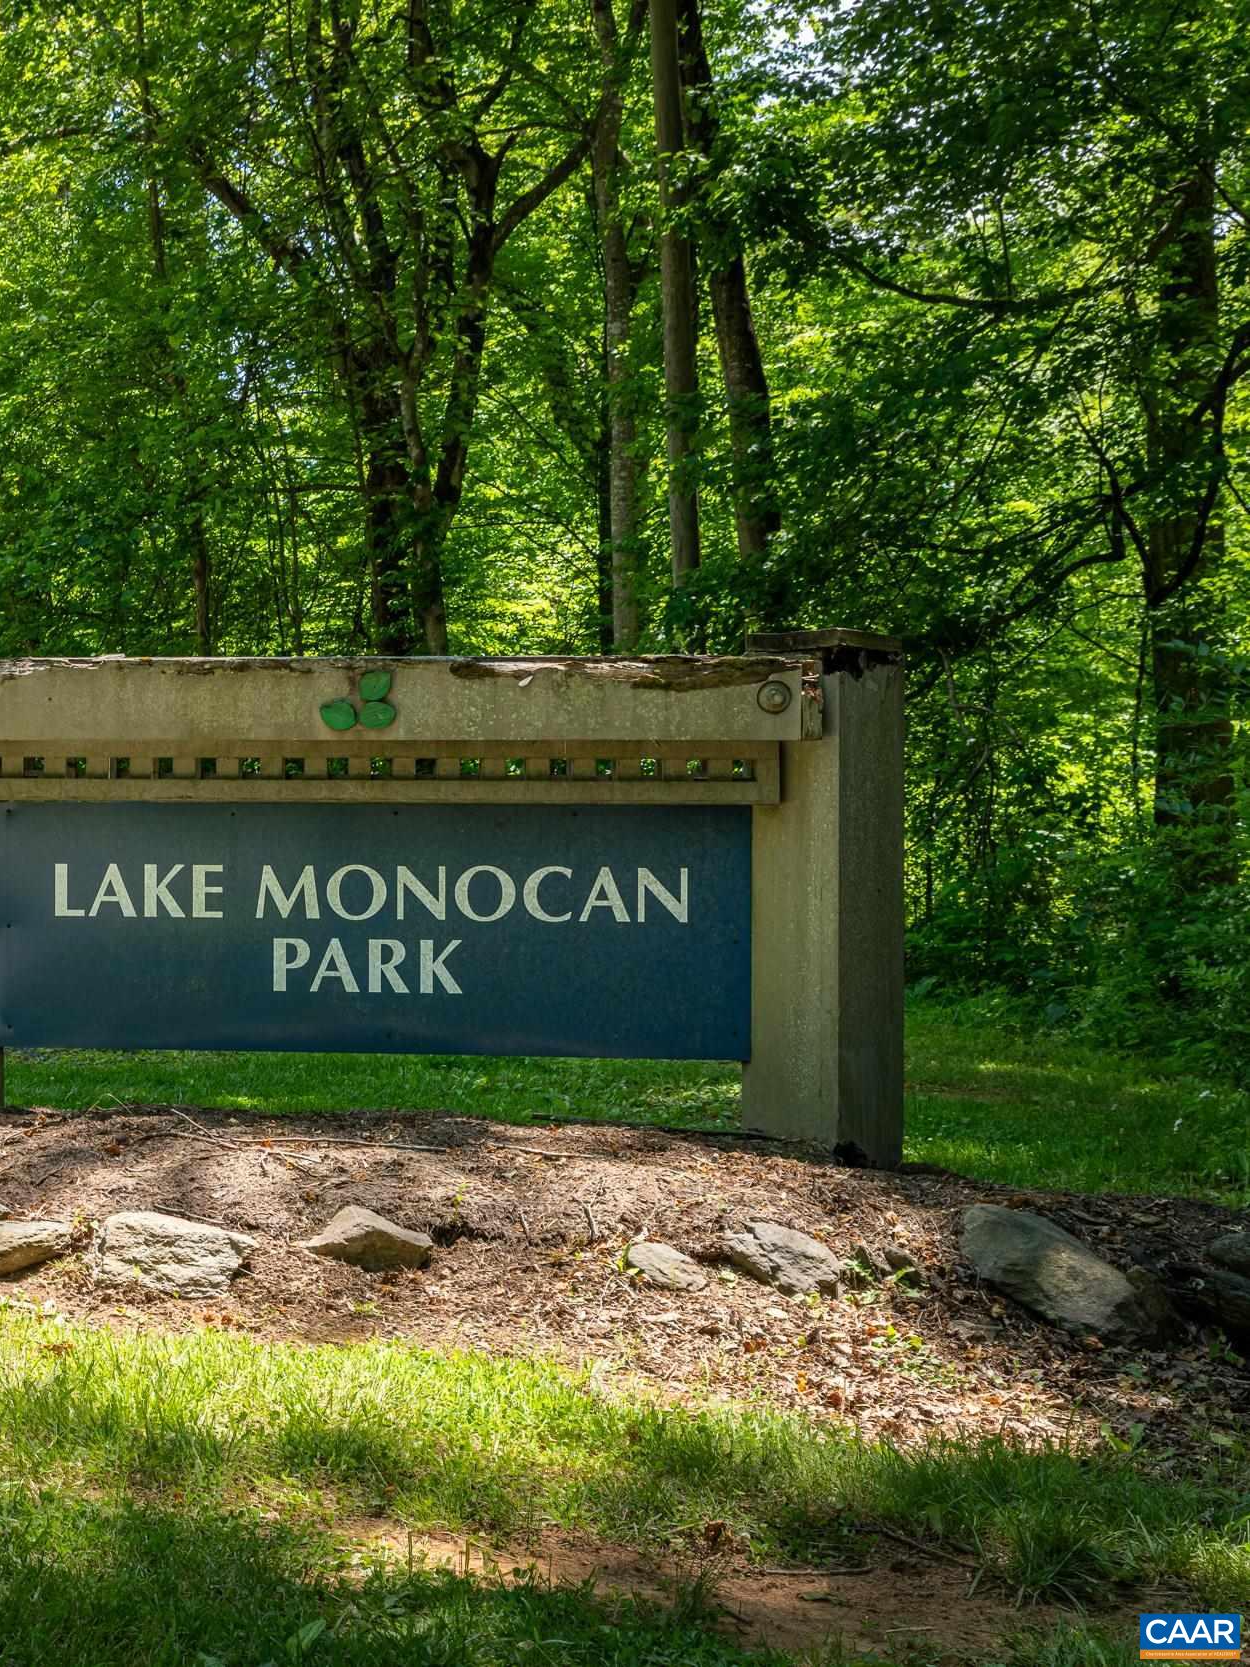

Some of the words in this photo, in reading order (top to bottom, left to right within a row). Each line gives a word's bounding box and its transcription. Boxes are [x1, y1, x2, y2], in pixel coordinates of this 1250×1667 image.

[54, 863, 224, 919] LAKE
[255, 864, 688, 923] MONOCAN
[273, 938, 463, 994] PARK
